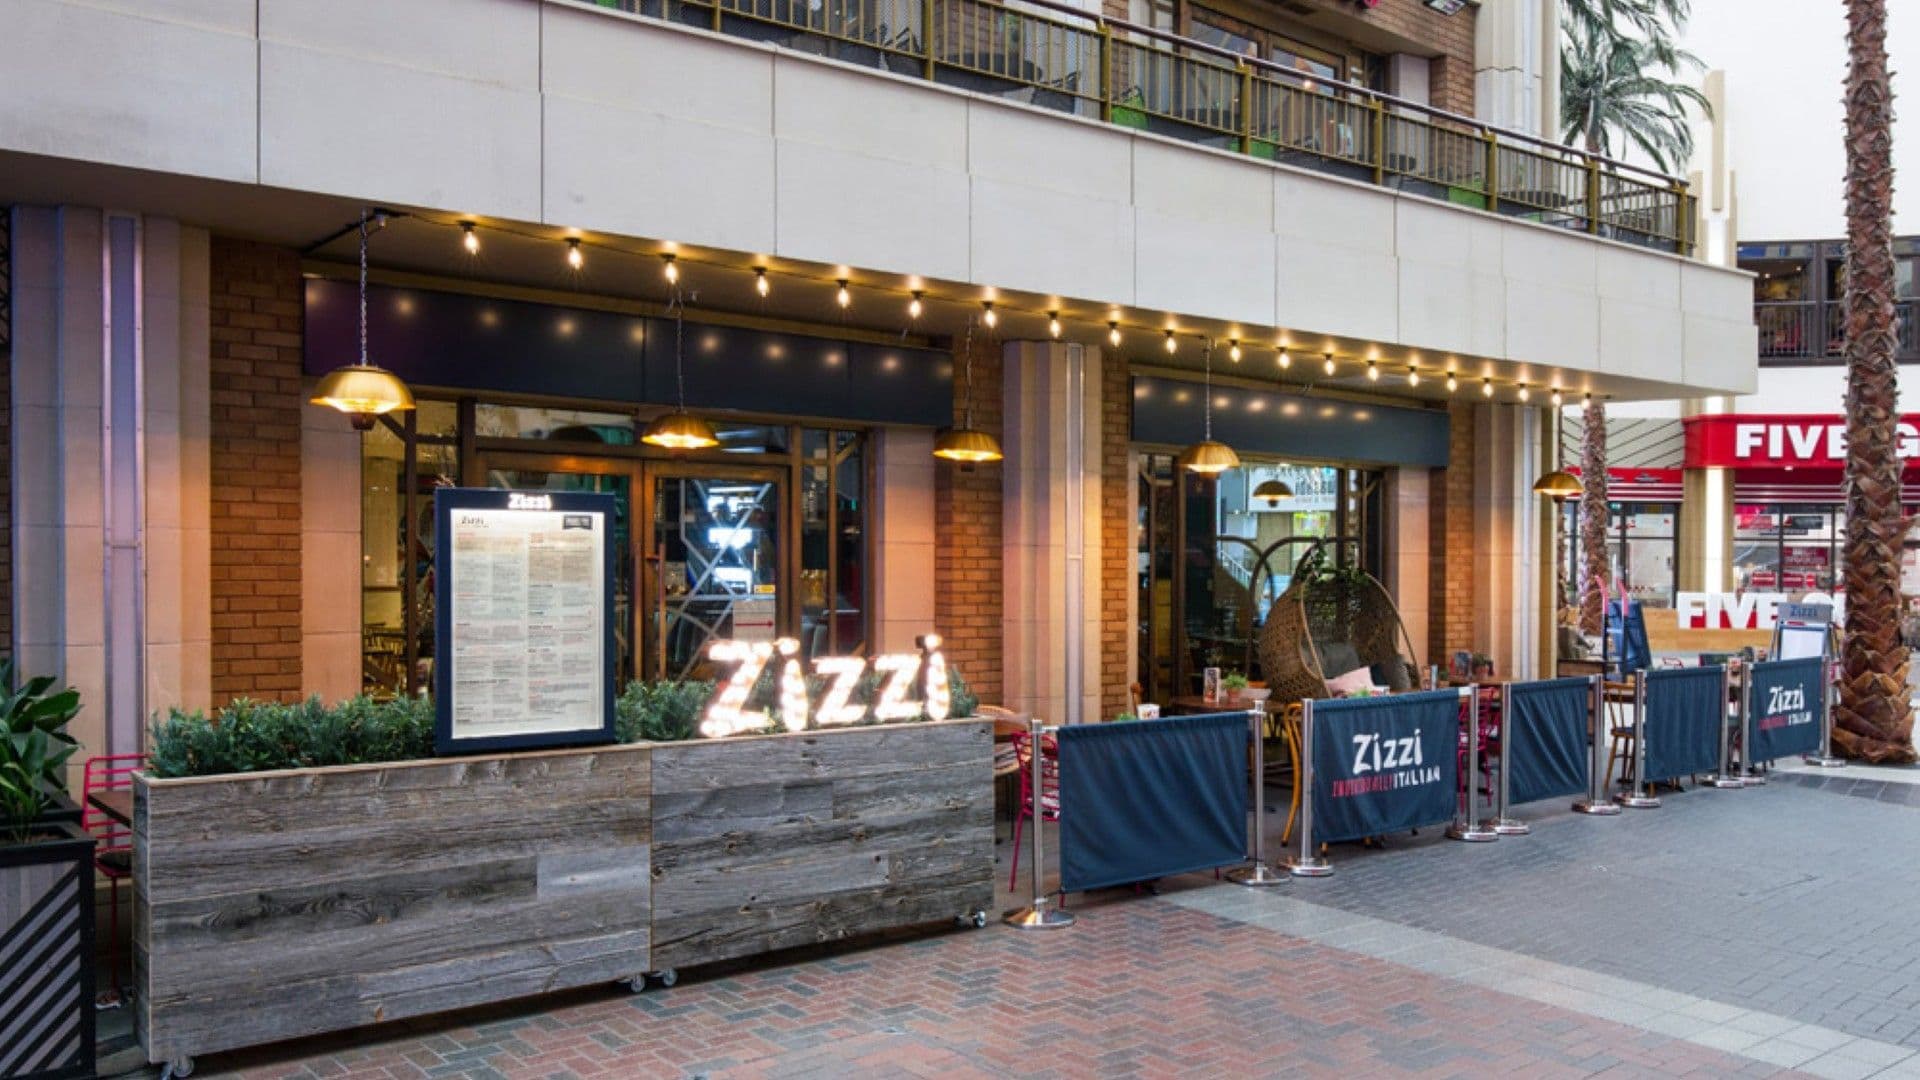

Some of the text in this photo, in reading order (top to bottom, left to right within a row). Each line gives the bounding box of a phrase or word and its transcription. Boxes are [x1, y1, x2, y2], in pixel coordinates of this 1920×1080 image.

[1735, 423, 1848, 459] FIVE
[1677, 592, 1787, 630] FIVE
[700, 634, 951, 737] Zizzi
[1767, 683, 1805, 714] Zizzi
[1352, 728, 1423, 774] Zizzi
